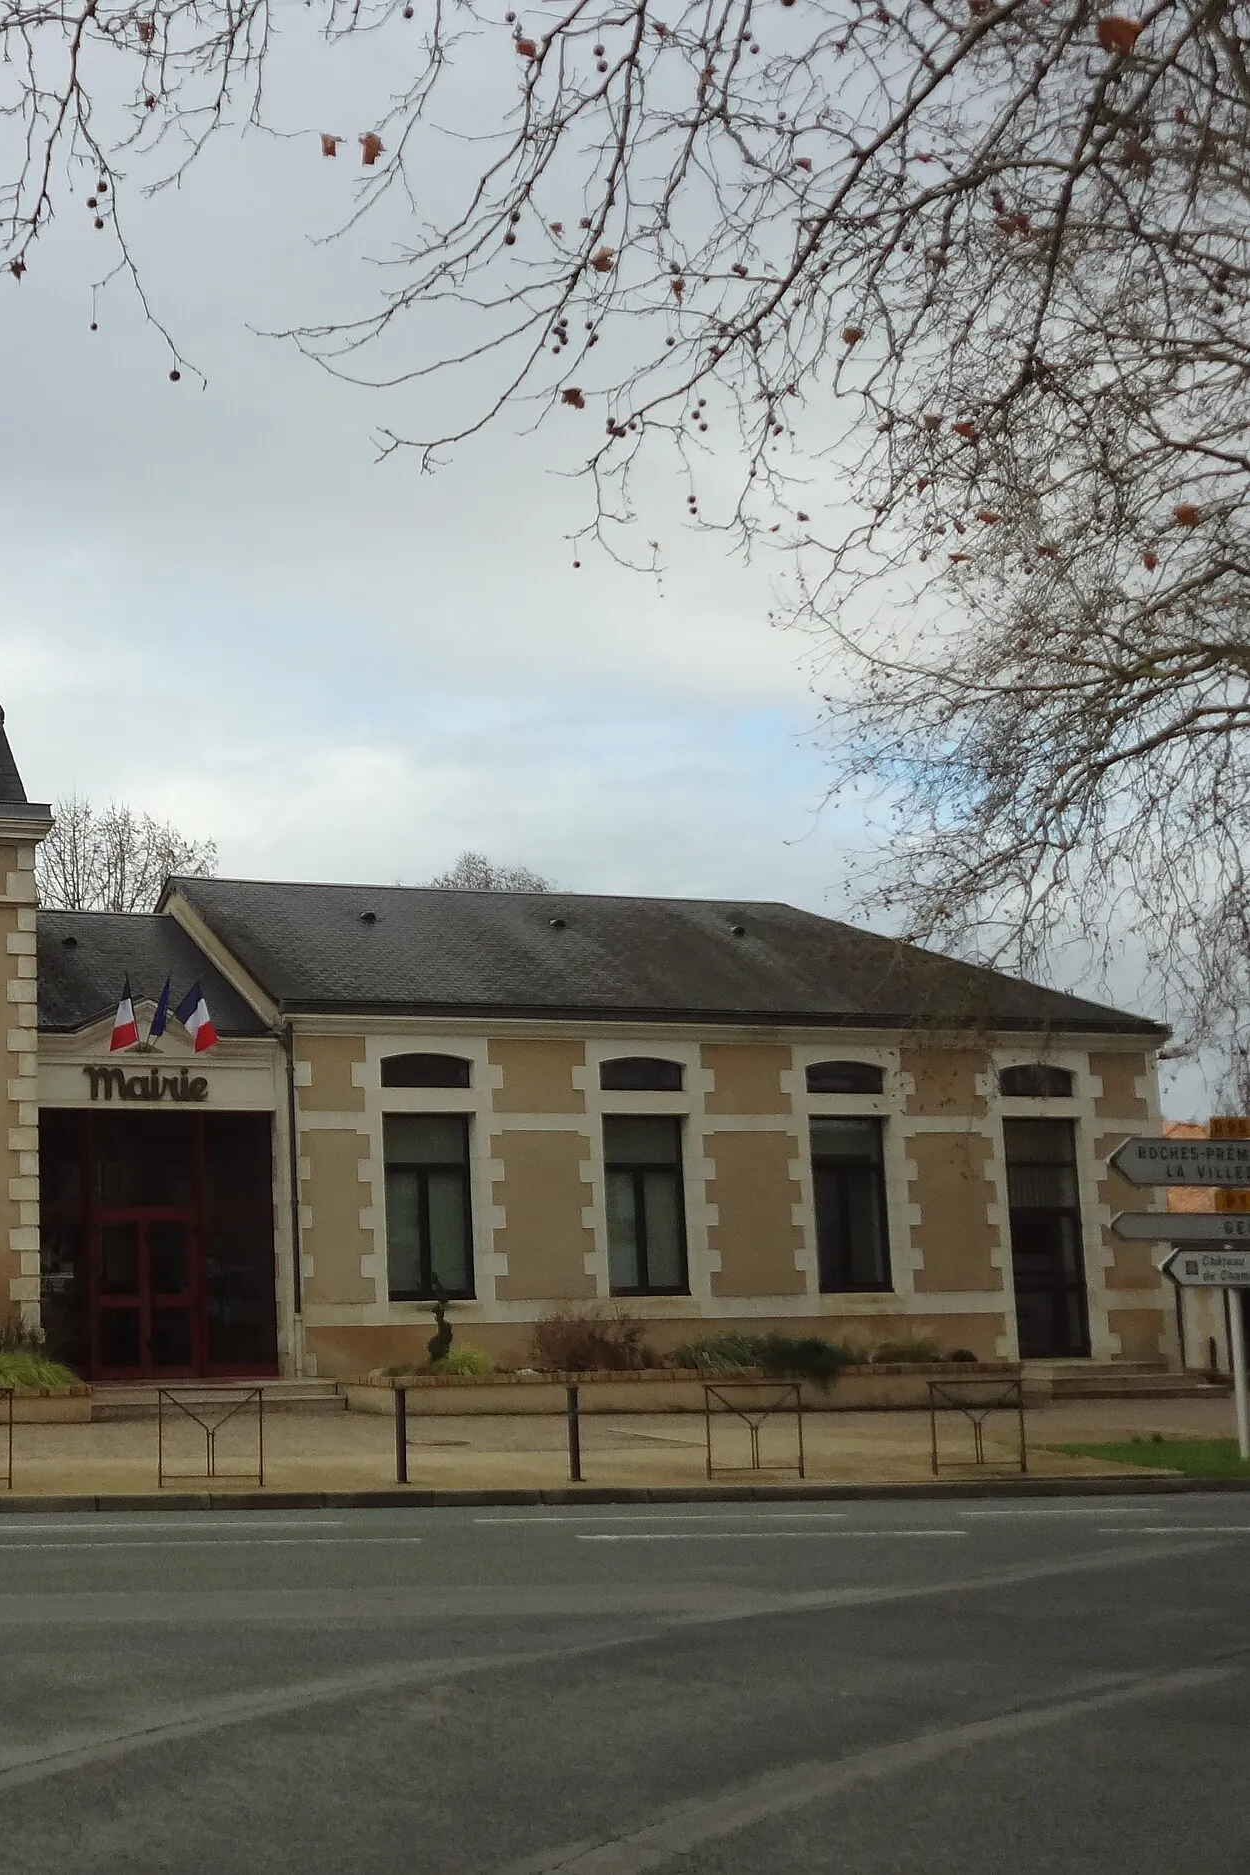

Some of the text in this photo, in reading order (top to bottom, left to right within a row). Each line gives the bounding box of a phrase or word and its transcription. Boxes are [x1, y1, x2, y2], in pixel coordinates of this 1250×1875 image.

[82, 1065, 209, 1101] Mairie
[1166, 1164, 1185, 1178] LA
[1225, 1220, 1250, 1234] GE
